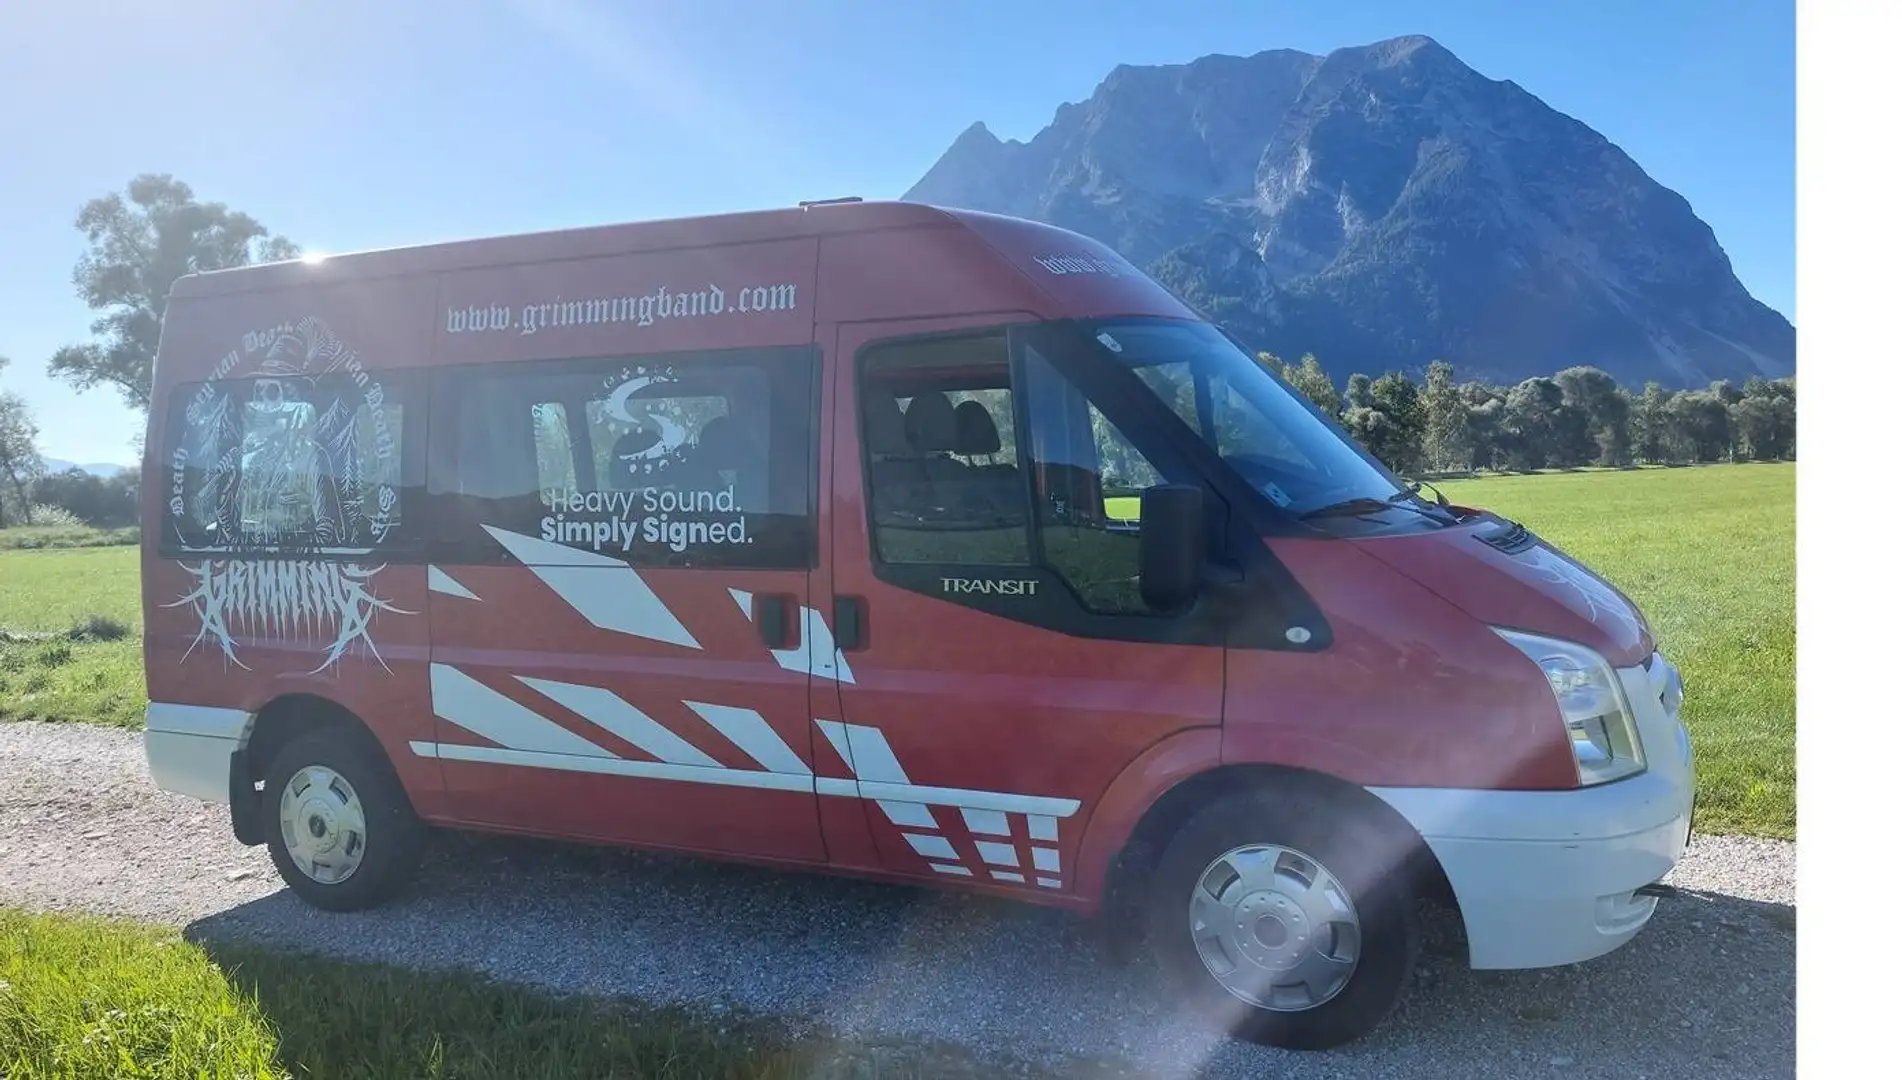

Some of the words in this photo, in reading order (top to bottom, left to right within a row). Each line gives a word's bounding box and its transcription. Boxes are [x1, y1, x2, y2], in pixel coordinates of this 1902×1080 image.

[445, 284, 797, 335] www.grimmingband.com
[551, 486, 635, 520] Heavy
[643, 484, 742, 513] Sound.
[541, 514, 638, 551] Simply
[643, 514, 753, 552] Signed.
[940, 577, 1039, 595] TRANSIT
